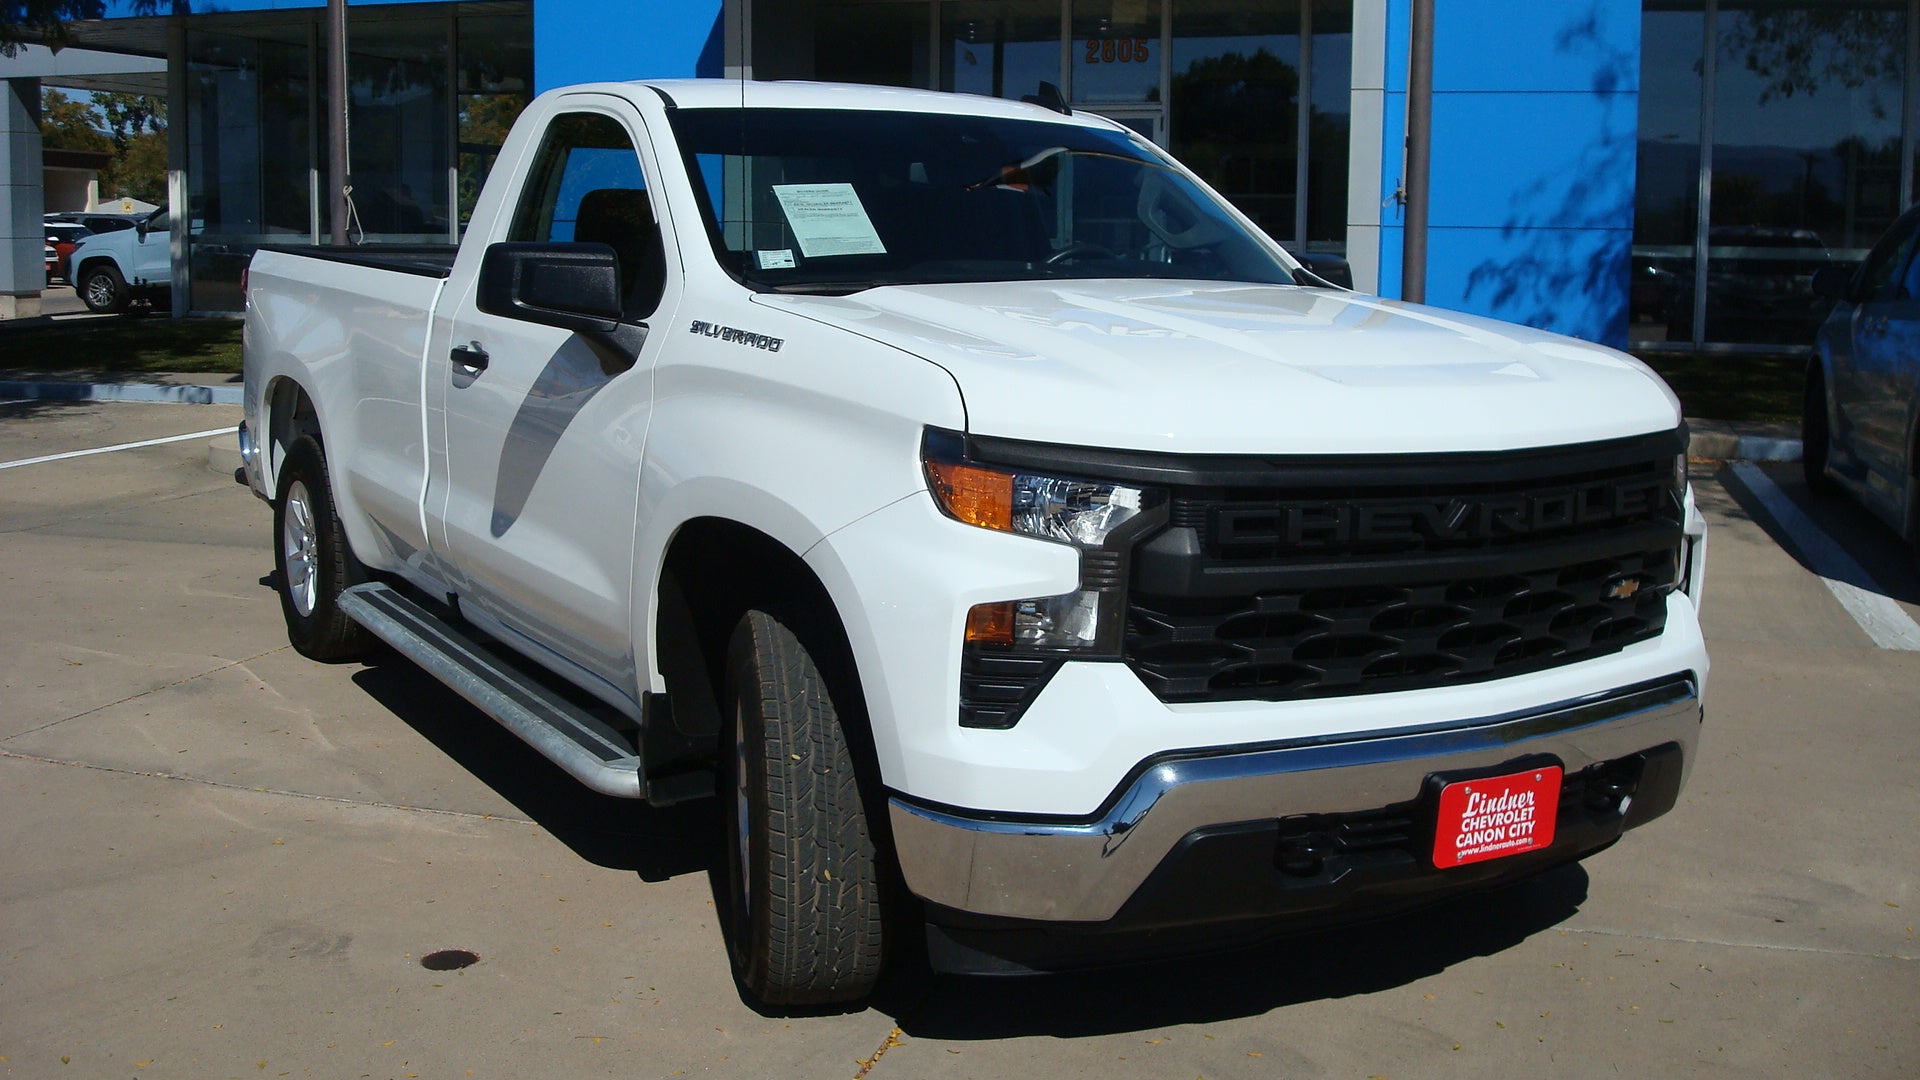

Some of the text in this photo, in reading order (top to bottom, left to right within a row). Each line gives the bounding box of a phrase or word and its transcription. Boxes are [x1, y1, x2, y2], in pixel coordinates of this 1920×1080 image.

[1086, 38, 1149, 63] 2805
[690, 320, 784, 352] SILVERADO
[1214, 484, 1672, 546] CHEVROLET
[1462, 788, 1535, 818] Lindner
[1461, 806, 1536, 832] CHEVROLET
[1456, 826, 1506, 848] CANON
[1509, 820, 1536, 838] CITY
[1461, 837, 1528, 856] www.lindnerauto.com
